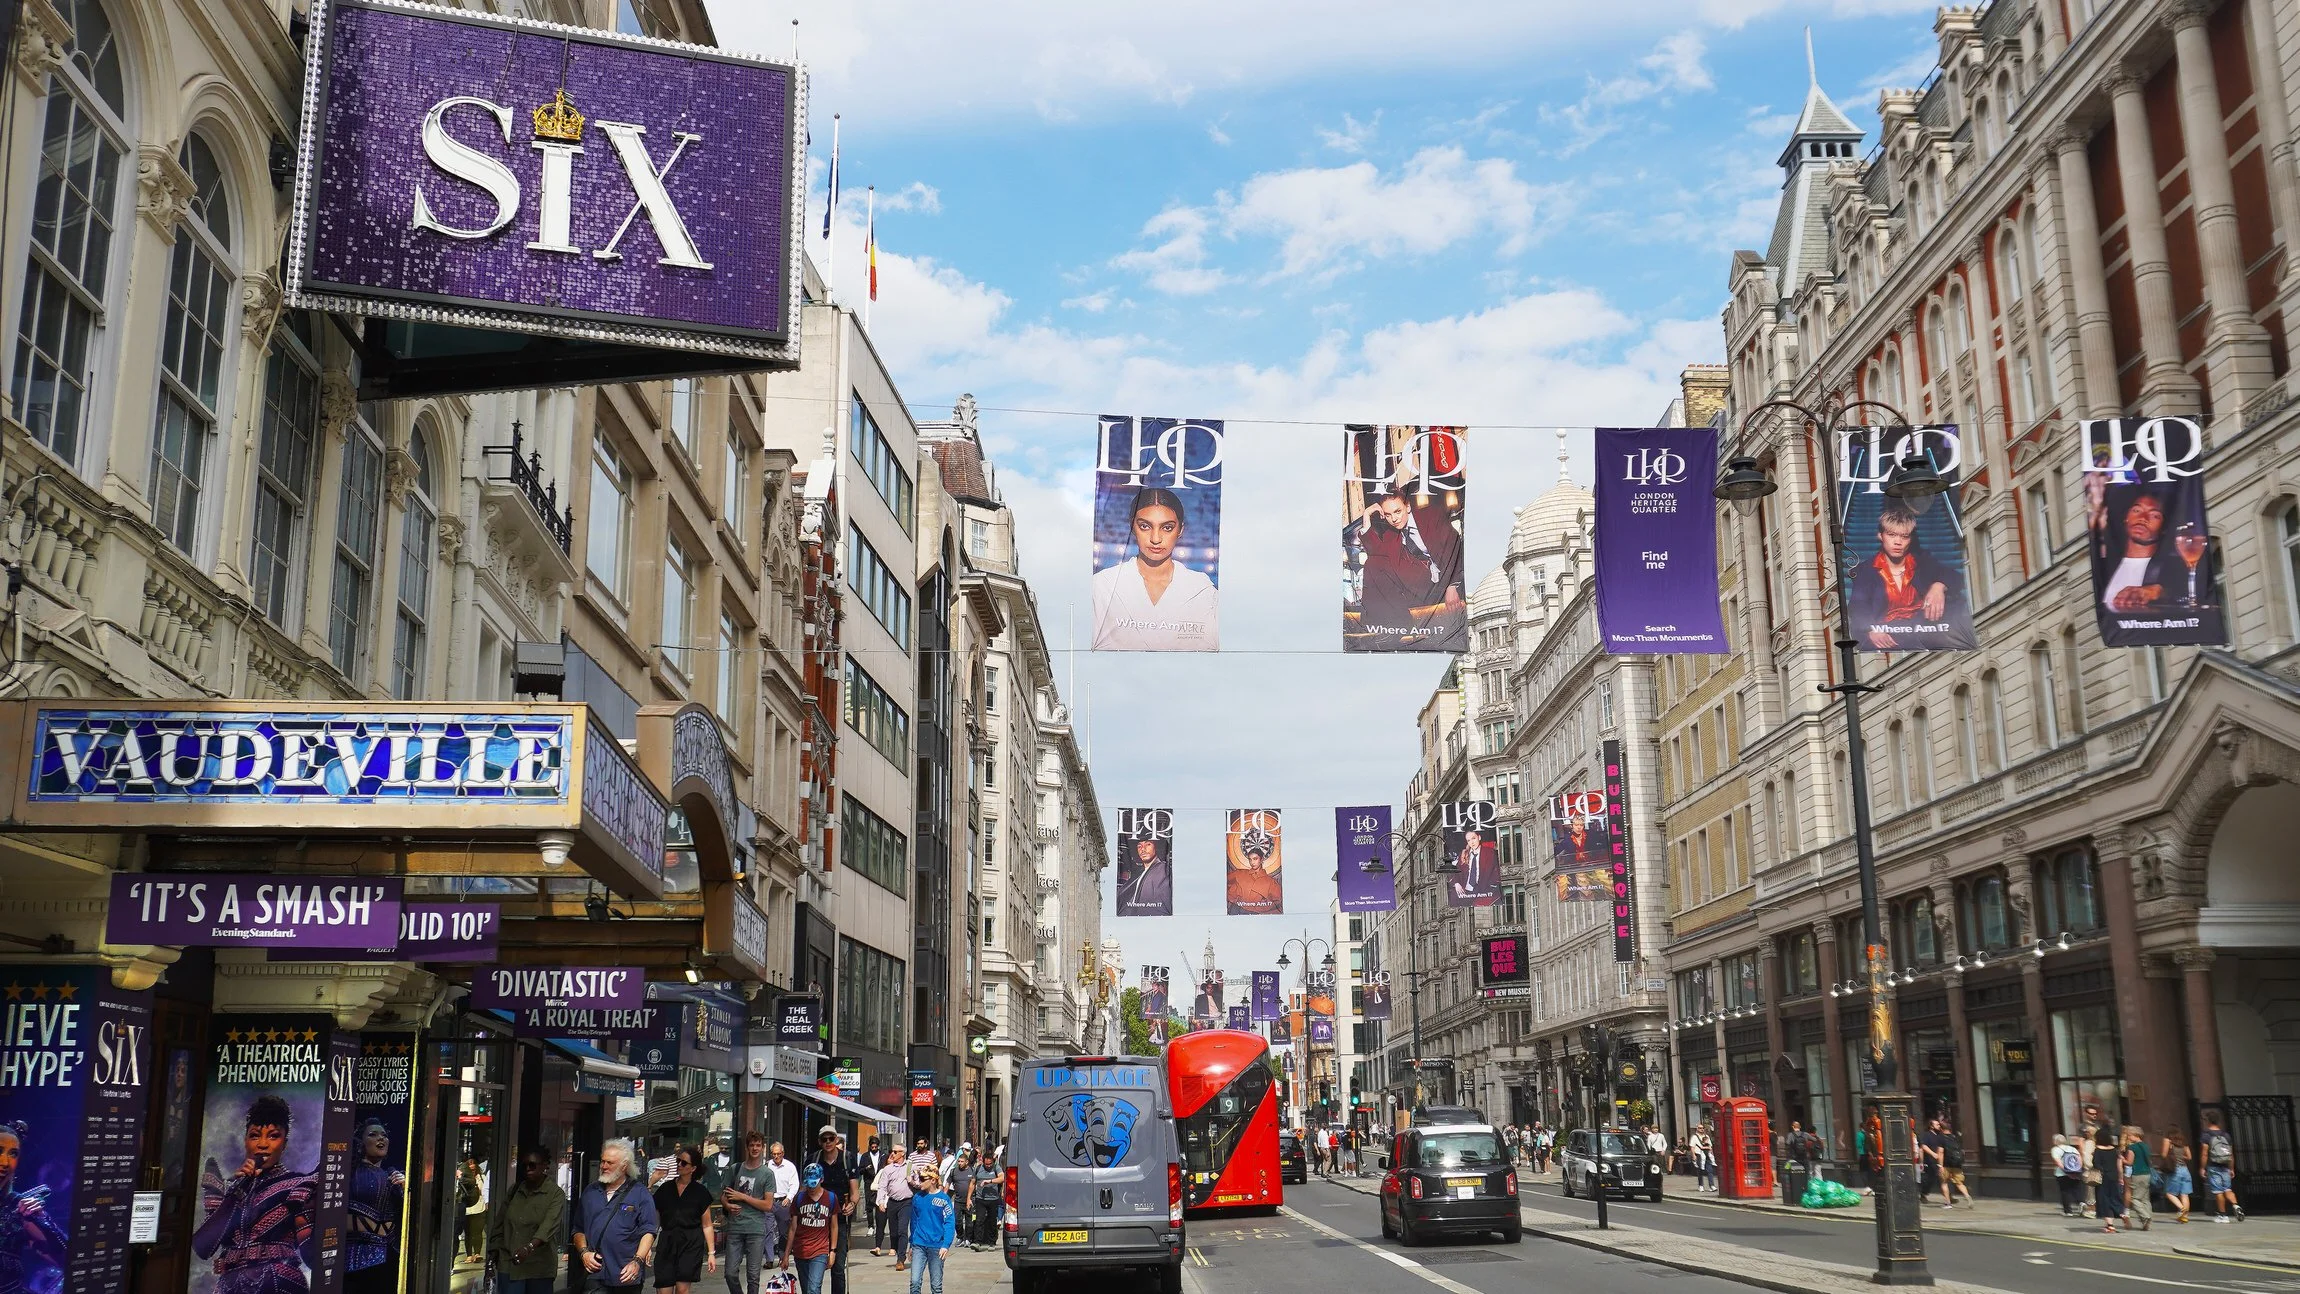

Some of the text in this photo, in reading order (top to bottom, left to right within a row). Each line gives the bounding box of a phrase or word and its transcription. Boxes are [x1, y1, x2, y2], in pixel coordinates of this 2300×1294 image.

[2081, 416, 2204, 484] LHQ
[1622, 447, 1688, 486] LHQ
[1634, 492, 1675, 500] LONDON
[1632, 506, 1677, 514] QUARTER
[1642, 551, 1668, 561] Find
[1116, 618, 1157, 629] Where
[1160, 621, 1179, 630] Am
[1870, 623, 1950, 633] Where Am I?
[2117, 617, 2200, 629] Where Am I?
[1366, 624, 1444, 635] Where Am I?
[48, 726, 564, 791] VAUDEVILLE
[1349, 815, 1379, 832] LHQ
[1607, 764, 1630, 938] BURLESQUE
[218, 884, 241, 923] A
[254, 884, 384, 926] SMASH’
[400, 913, 443, 940] OLID
[1490, 940, 1516, 952] BUR
[1491, 951, 1514, 963] LES
[1491, 962, 1517, 977] QUE
[491, 970, 626, 998] ‘DIVATASTIC’
[1508, 988, 1531, 996] MUSICA
[545, 998, 568, 1007] Mirror
[711, 1007, 731, 1024] STANLEY
[788, 1006, 807, 1014] THE
[546, 1008, 596, 1028] ROYAL
[602, 1008, 657, 1029] TREAT’
[785, 1016, 811, 1024] REAL
[0, 1004, 80, 1046] IEVE
[782, 1025, 813, 1033] GREEK
[709, 1023, 731, 1045] GIBBONS
[236, 1044, 321, 1063] THEATRICAL
[358, 1056, 409, 1068] SASSY LYRICS
[217, 1064, 326, 1083] PHENOMENON’
[380, 1067, 408, 1080] TUNES
[1035, 1068, 1150, 1088] UPSTAGE
[356, 1080, 407, 1092] OUR SOCKS
[914, 1079, 931, 1087] Dyas
[1225, 1099, 1233, 1112] 9
[801, 1217, 826, 1228] MILANO
[1044, 1231, 1087, 1241] UP52 AGE
